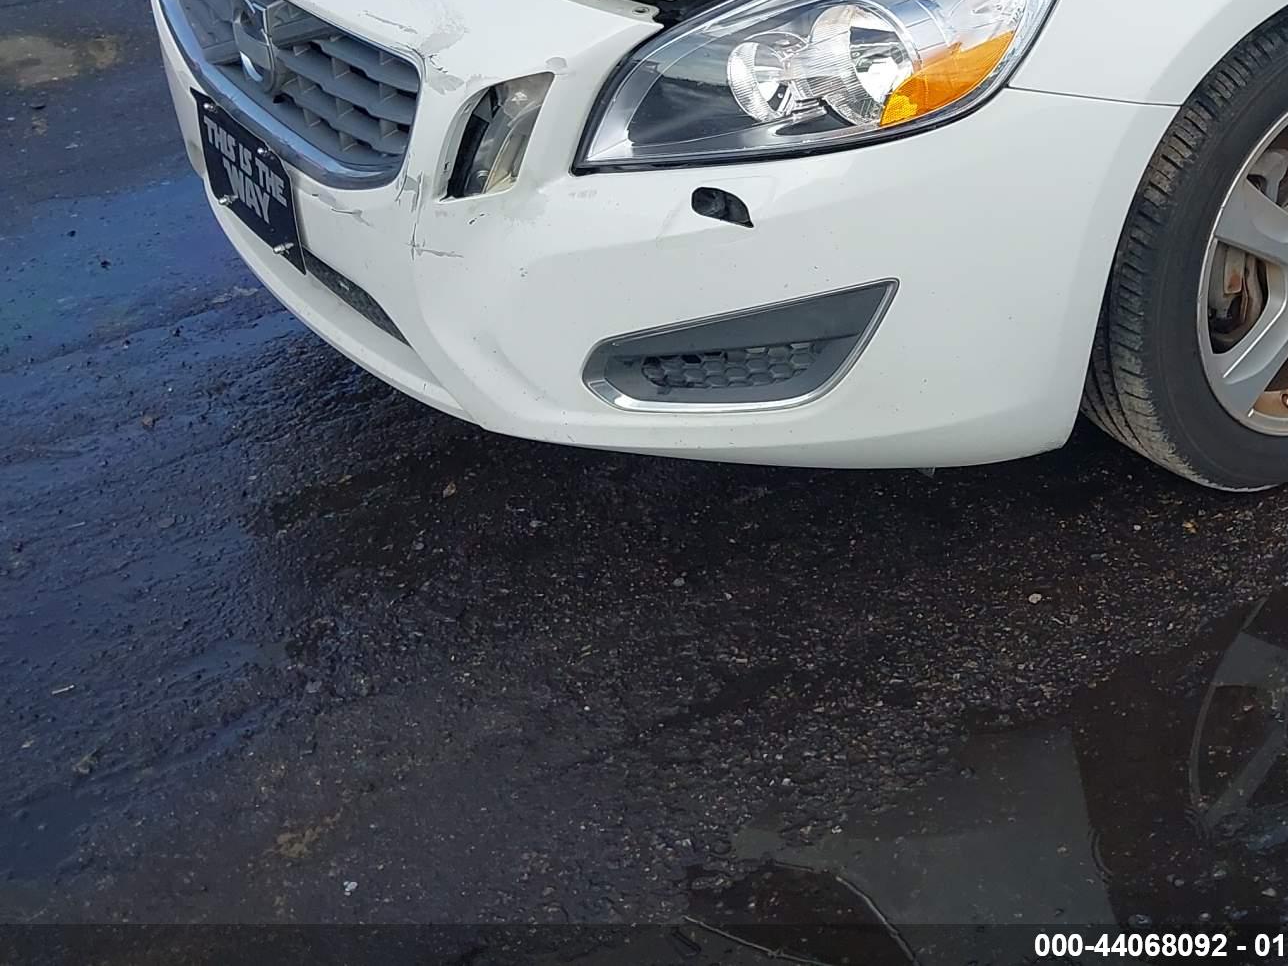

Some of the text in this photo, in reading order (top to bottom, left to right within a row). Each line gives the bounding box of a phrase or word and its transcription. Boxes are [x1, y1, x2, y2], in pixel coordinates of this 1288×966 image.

[203, 115, 288, 208] THIS IS THE
[222, 156, 271, 225] WAY
